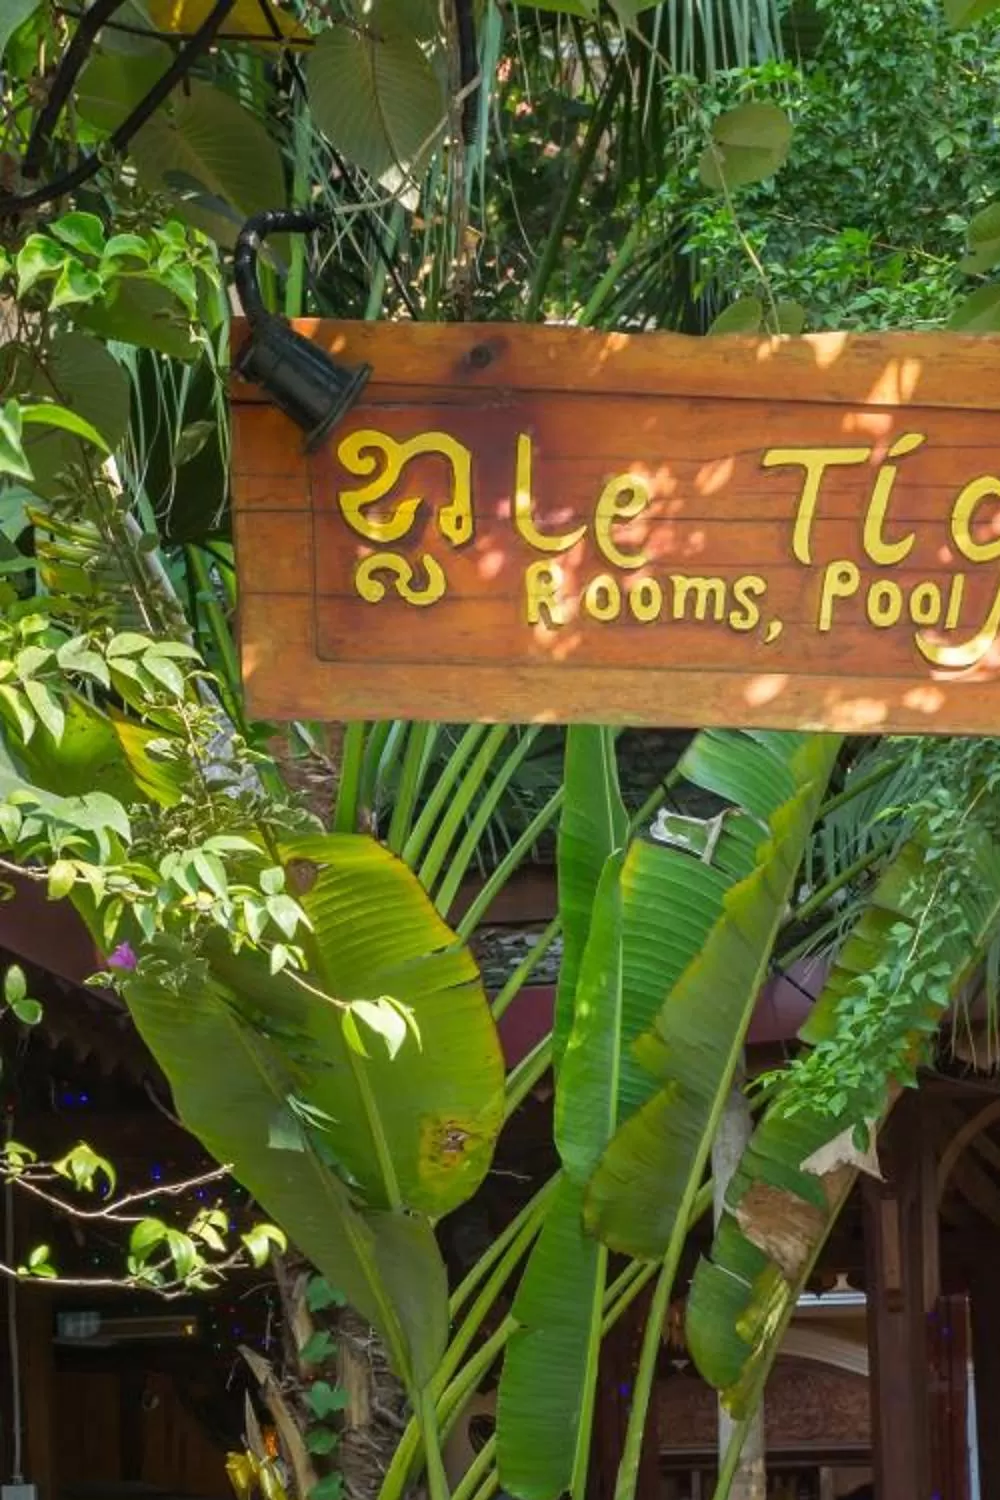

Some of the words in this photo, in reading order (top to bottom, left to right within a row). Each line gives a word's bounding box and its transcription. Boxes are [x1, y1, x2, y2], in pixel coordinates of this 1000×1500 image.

[515, 432, 650, 569] Le
[525, 560, 783, 644] Rooms,
[818, 560, 965, 632] Pool
